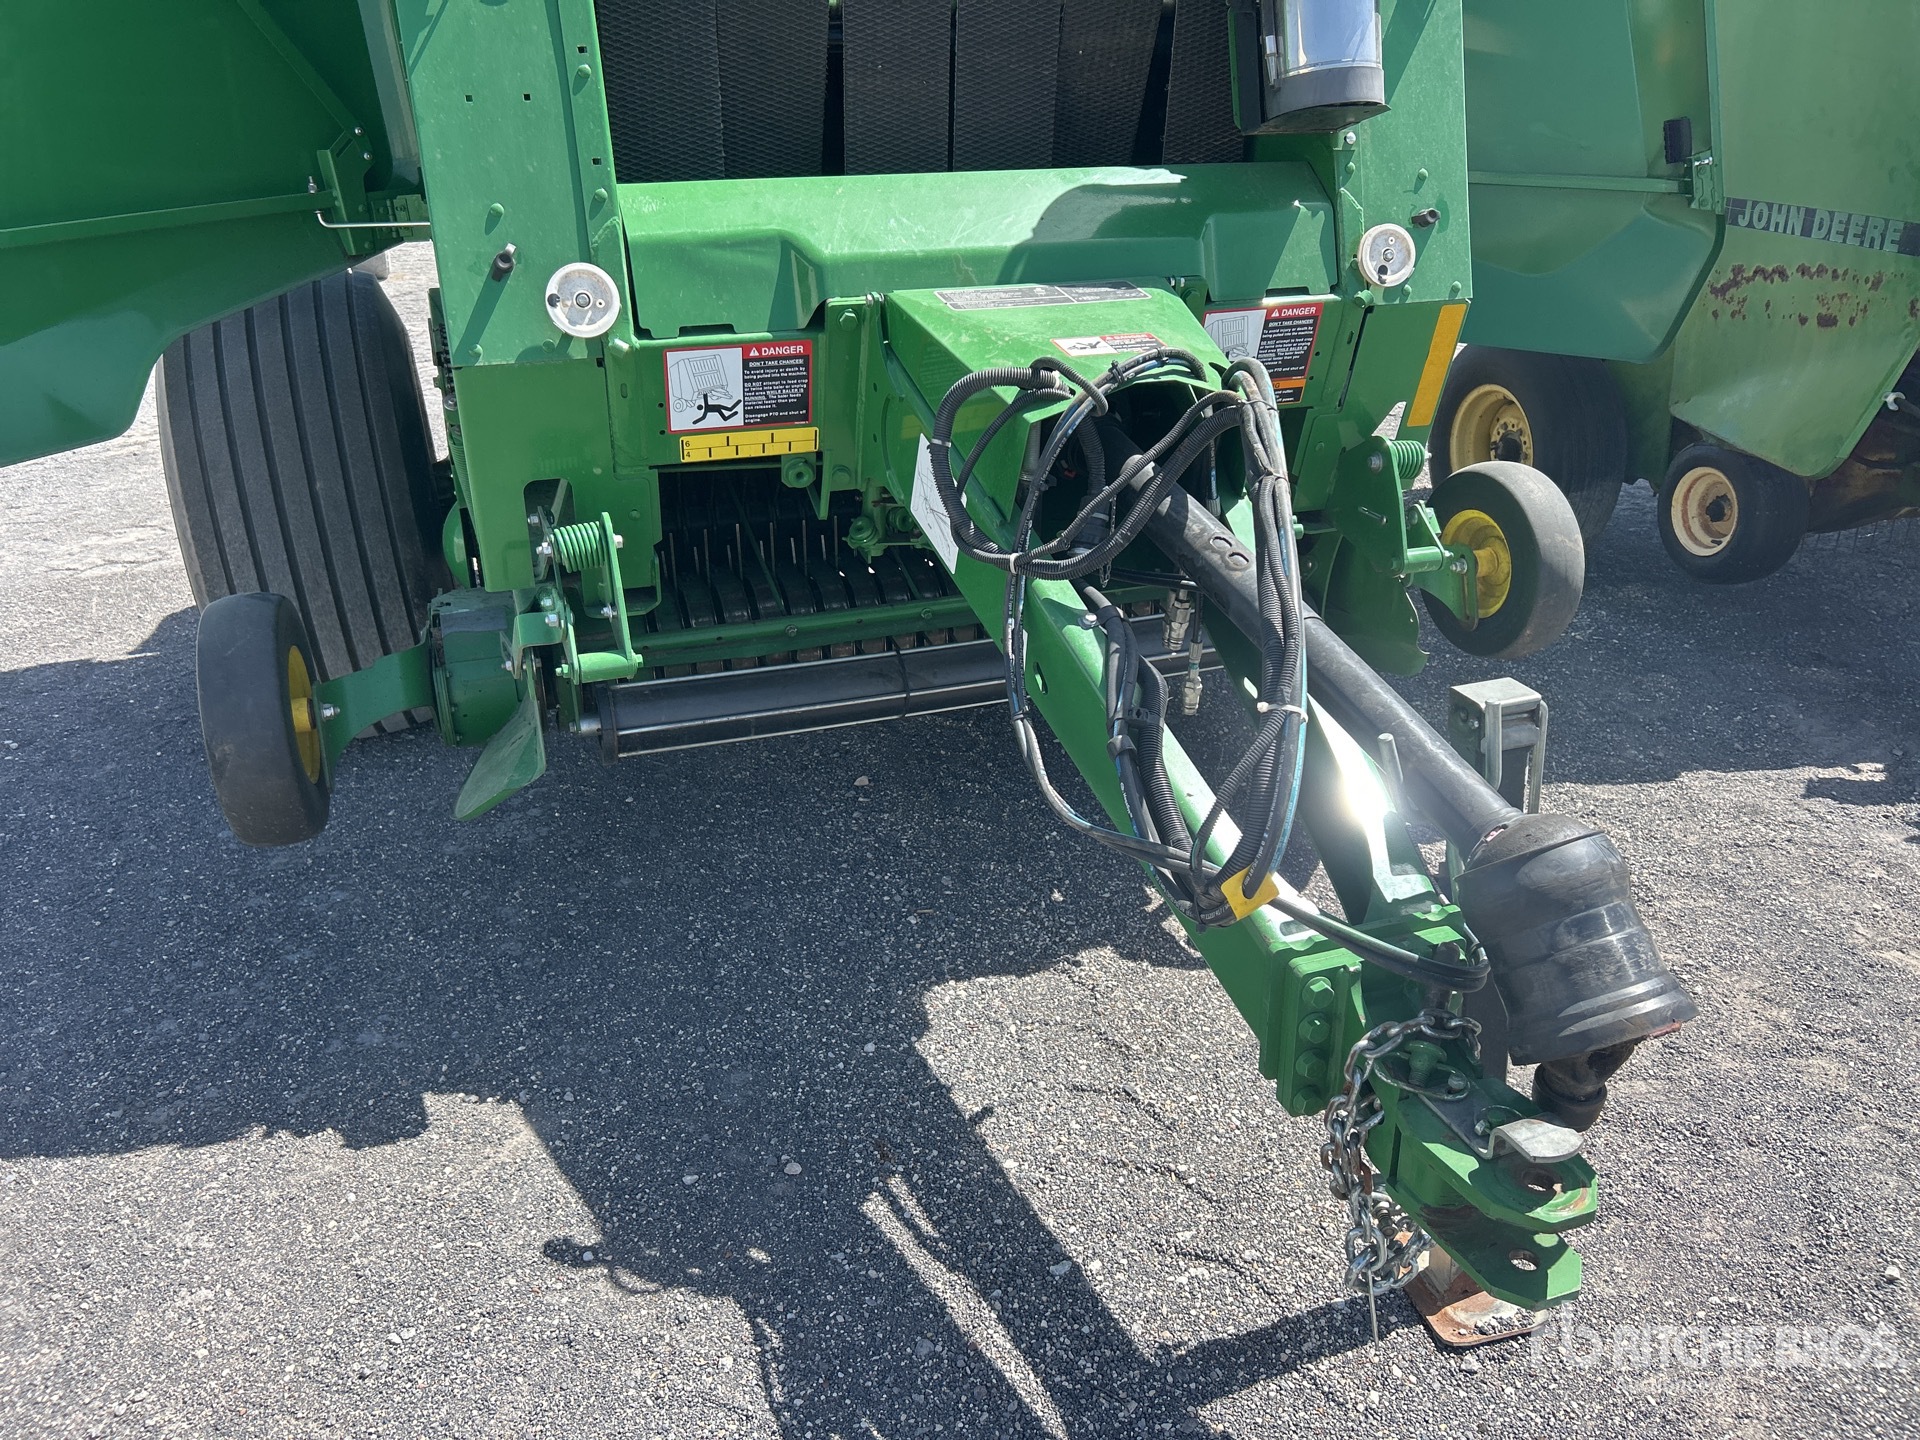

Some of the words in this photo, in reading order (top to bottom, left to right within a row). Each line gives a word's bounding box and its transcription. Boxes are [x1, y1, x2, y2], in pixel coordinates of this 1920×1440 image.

[1738, 201, 1805, 236] JOHN
[1811, 210, 1905, 252] DEERE
[1282, 307, 1316, 316] DANGER
[762, 346, 803, 356] DANGER
[1265, 812, 1274, 830] Flame
[1271, 782, 1280, 811] Resistant
